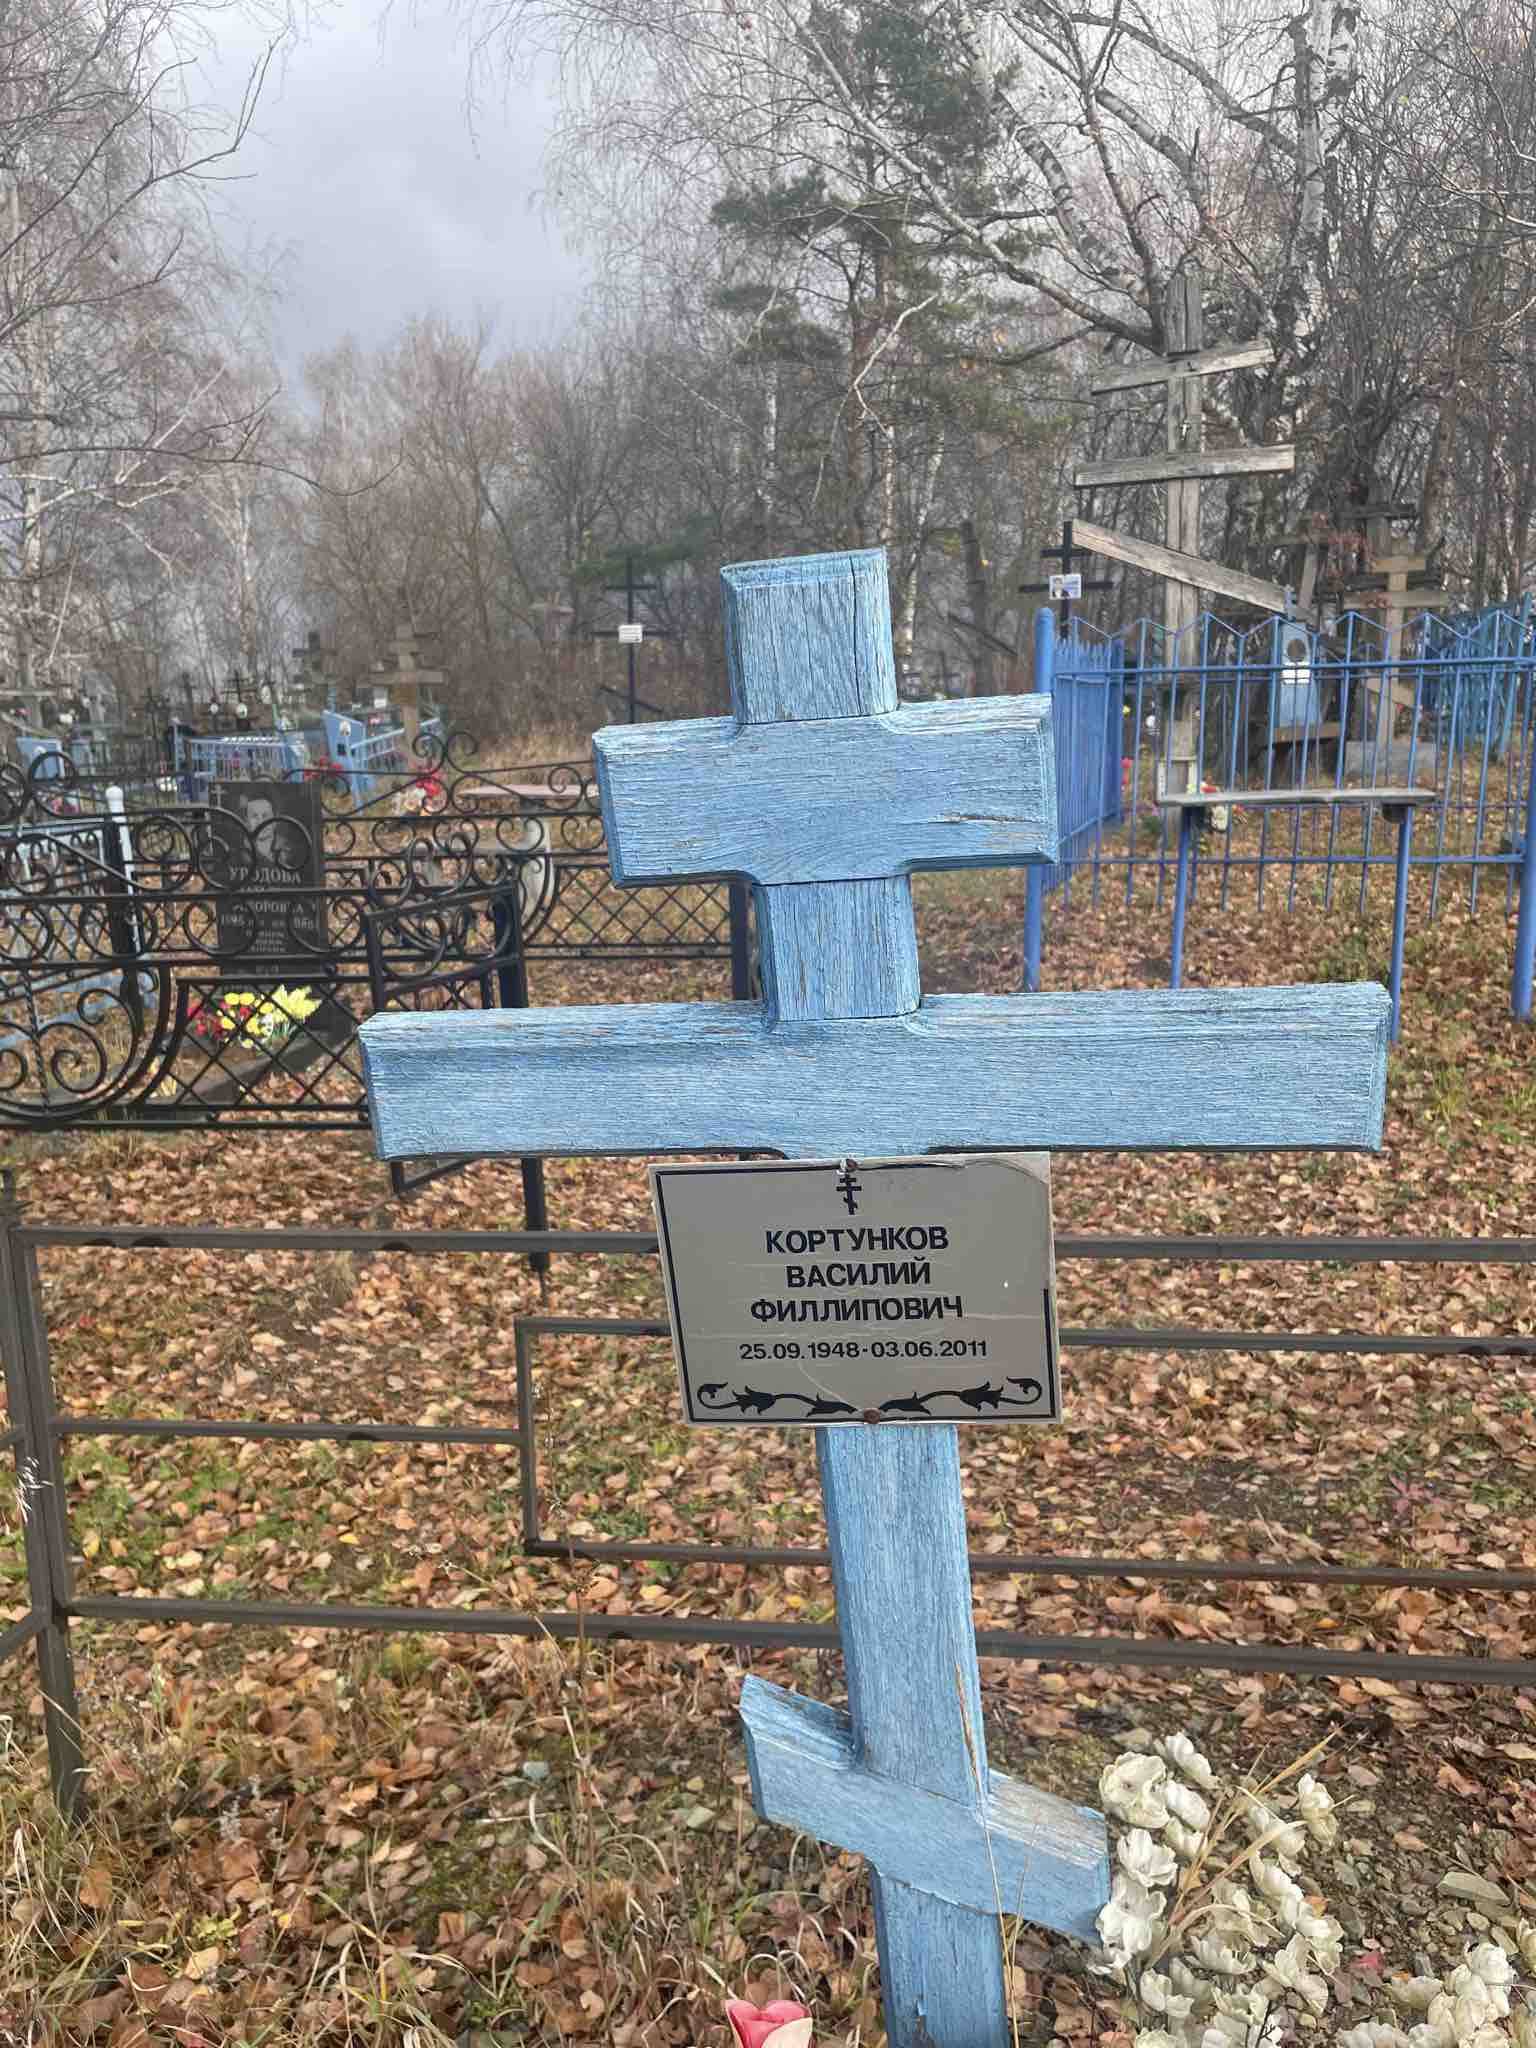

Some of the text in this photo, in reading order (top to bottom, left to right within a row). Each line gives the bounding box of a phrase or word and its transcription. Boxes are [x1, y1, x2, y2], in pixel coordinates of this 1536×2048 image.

[766, 1226, 948, 1253] КОРТУНКОВ
[786, 1257, 930, 1288] ВАСИЛИЙ
[750, 1296, 962, 1322] ФИЛЛИПОВИЧ
[739, 1340, 987, 1360] 25.09.1948-03.06.2011
